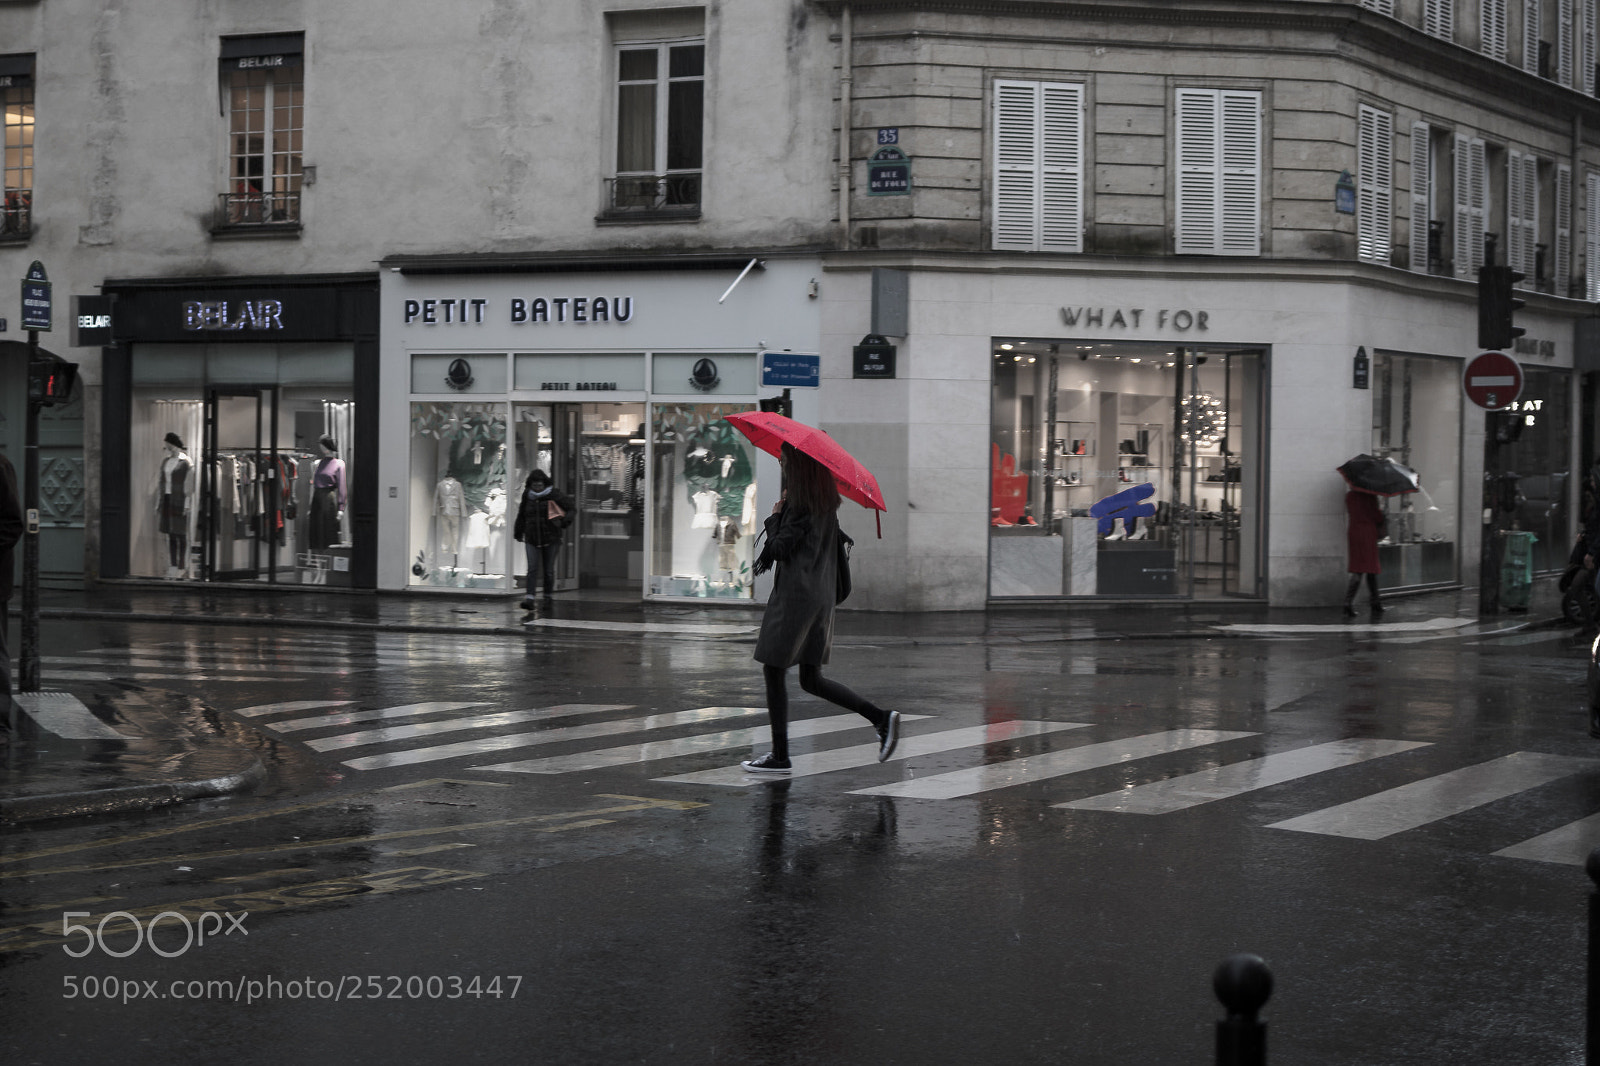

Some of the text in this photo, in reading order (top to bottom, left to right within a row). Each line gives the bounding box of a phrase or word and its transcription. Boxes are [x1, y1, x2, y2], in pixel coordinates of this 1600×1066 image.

[238, 56, 283, 68] BELAIR
[880, 129, 897, 143] 35
[182, 299, 284, 331] BELAIR
[404, 296, 632, 324] PETIT BATEAU
[77, 314, 112, 329] BELAIR
[1059, 306, 1210, 333] WHAT FOR
[541, 382, 617, 391] PETIT BATEAU
